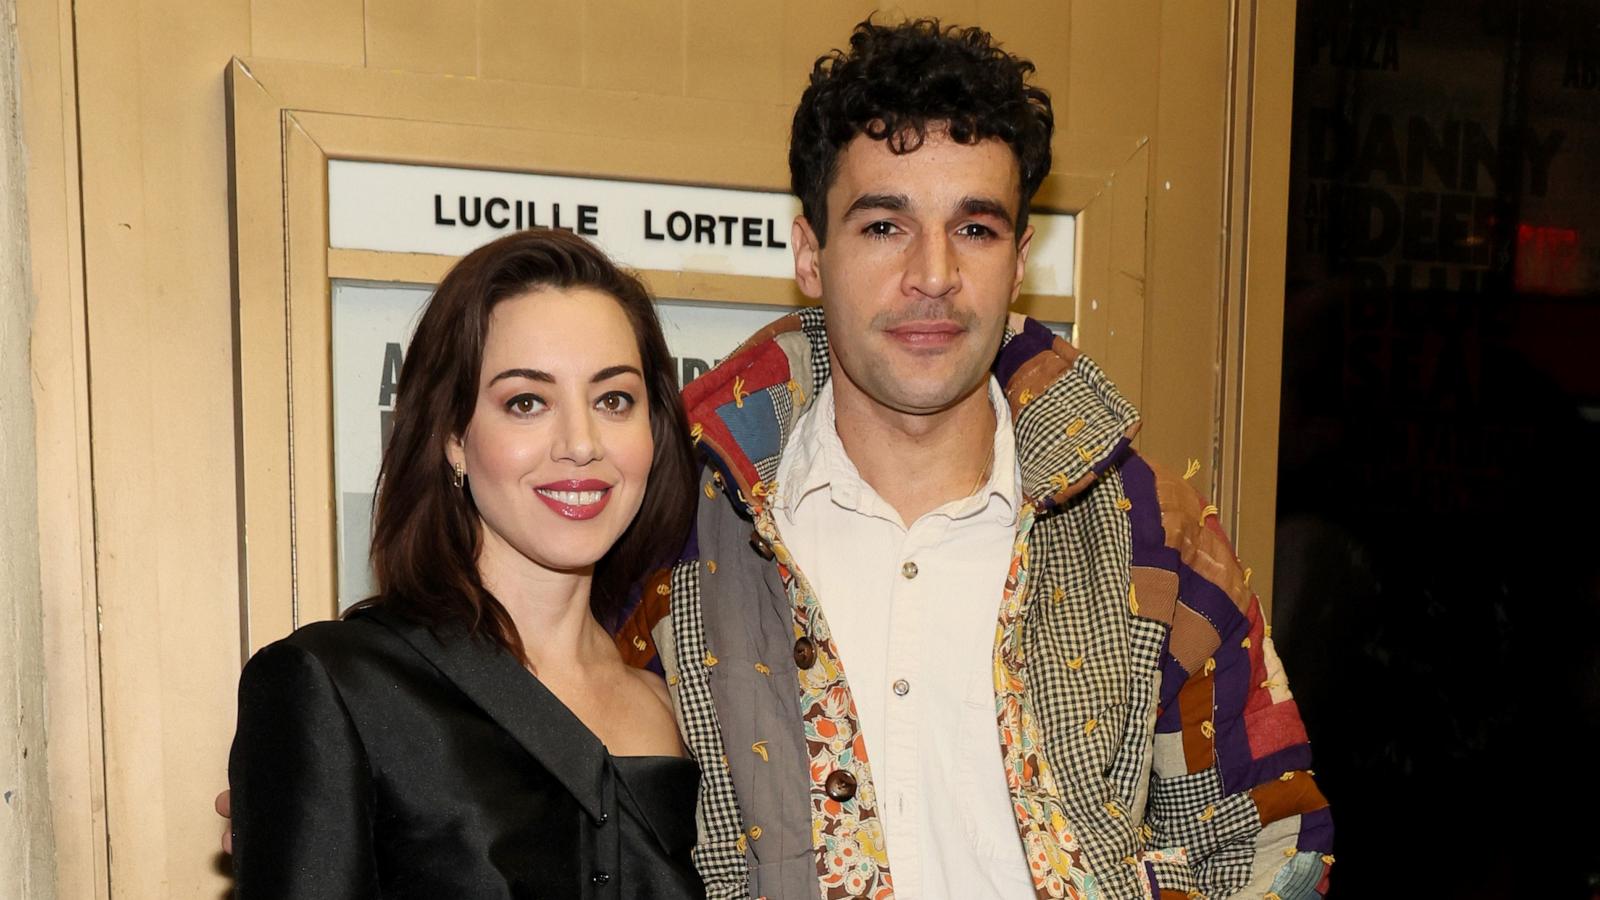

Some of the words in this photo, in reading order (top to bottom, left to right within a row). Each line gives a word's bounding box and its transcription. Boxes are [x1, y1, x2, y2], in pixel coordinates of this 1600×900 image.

[1308, 107, 1566, 197] DANNY
[434, 194, 599, 236] LUCILLE
[644, 209, 787, 249] LORTEL
